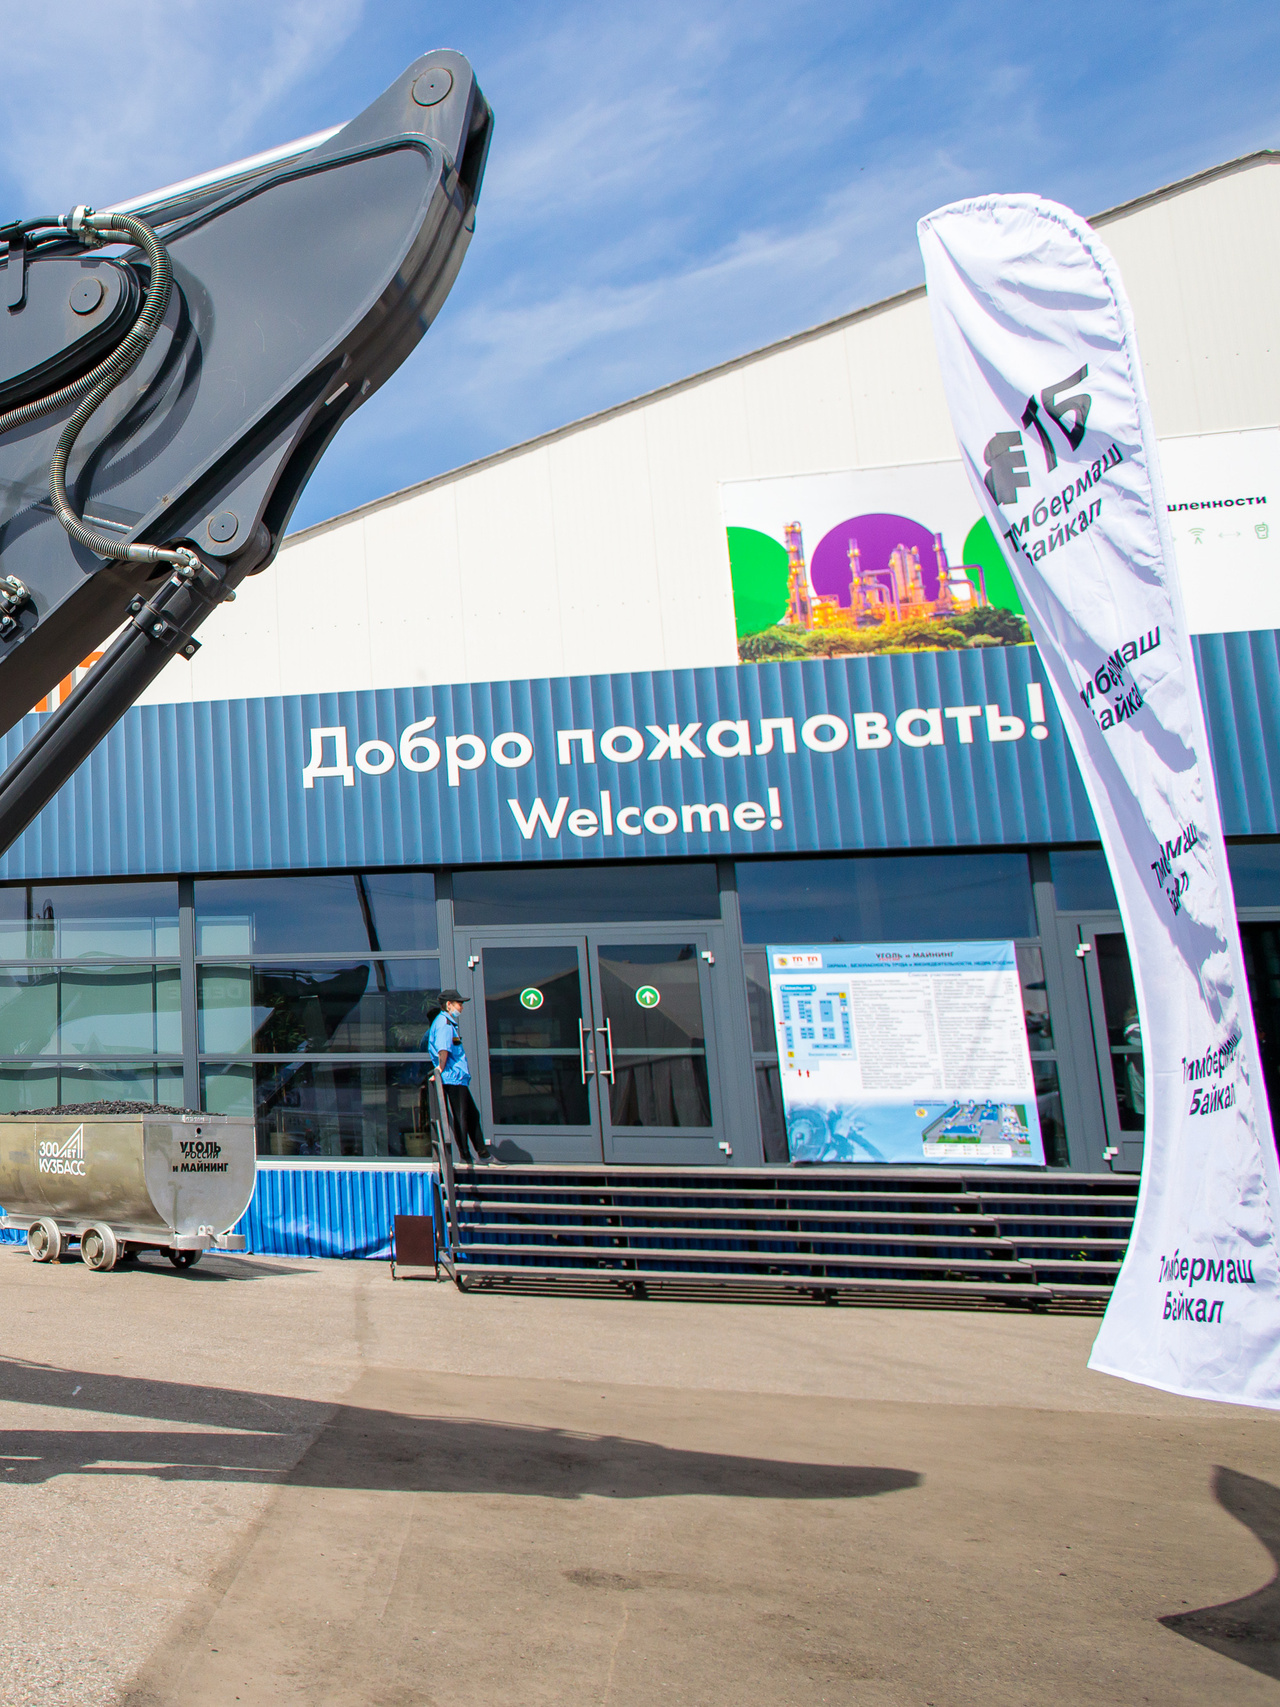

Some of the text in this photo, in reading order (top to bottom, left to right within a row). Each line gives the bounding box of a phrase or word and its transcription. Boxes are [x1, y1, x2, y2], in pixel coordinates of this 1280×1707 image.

[302, 682, 1050, 789] Добро пожаловать!
[507, 787, 784, 840] Welcome!
[39, 1141, 60, 1158] 300
[180, 1141, 222, 1154] УГОЛЬ
[184, 1151, 220, 1159] РОССИИ
[39, 1158, 87, 1177] КУЗБАСС
[180, 1160, 229, 1172] МАЙНИНГ
[1162, 1290, 1225, 1324] Байкал
